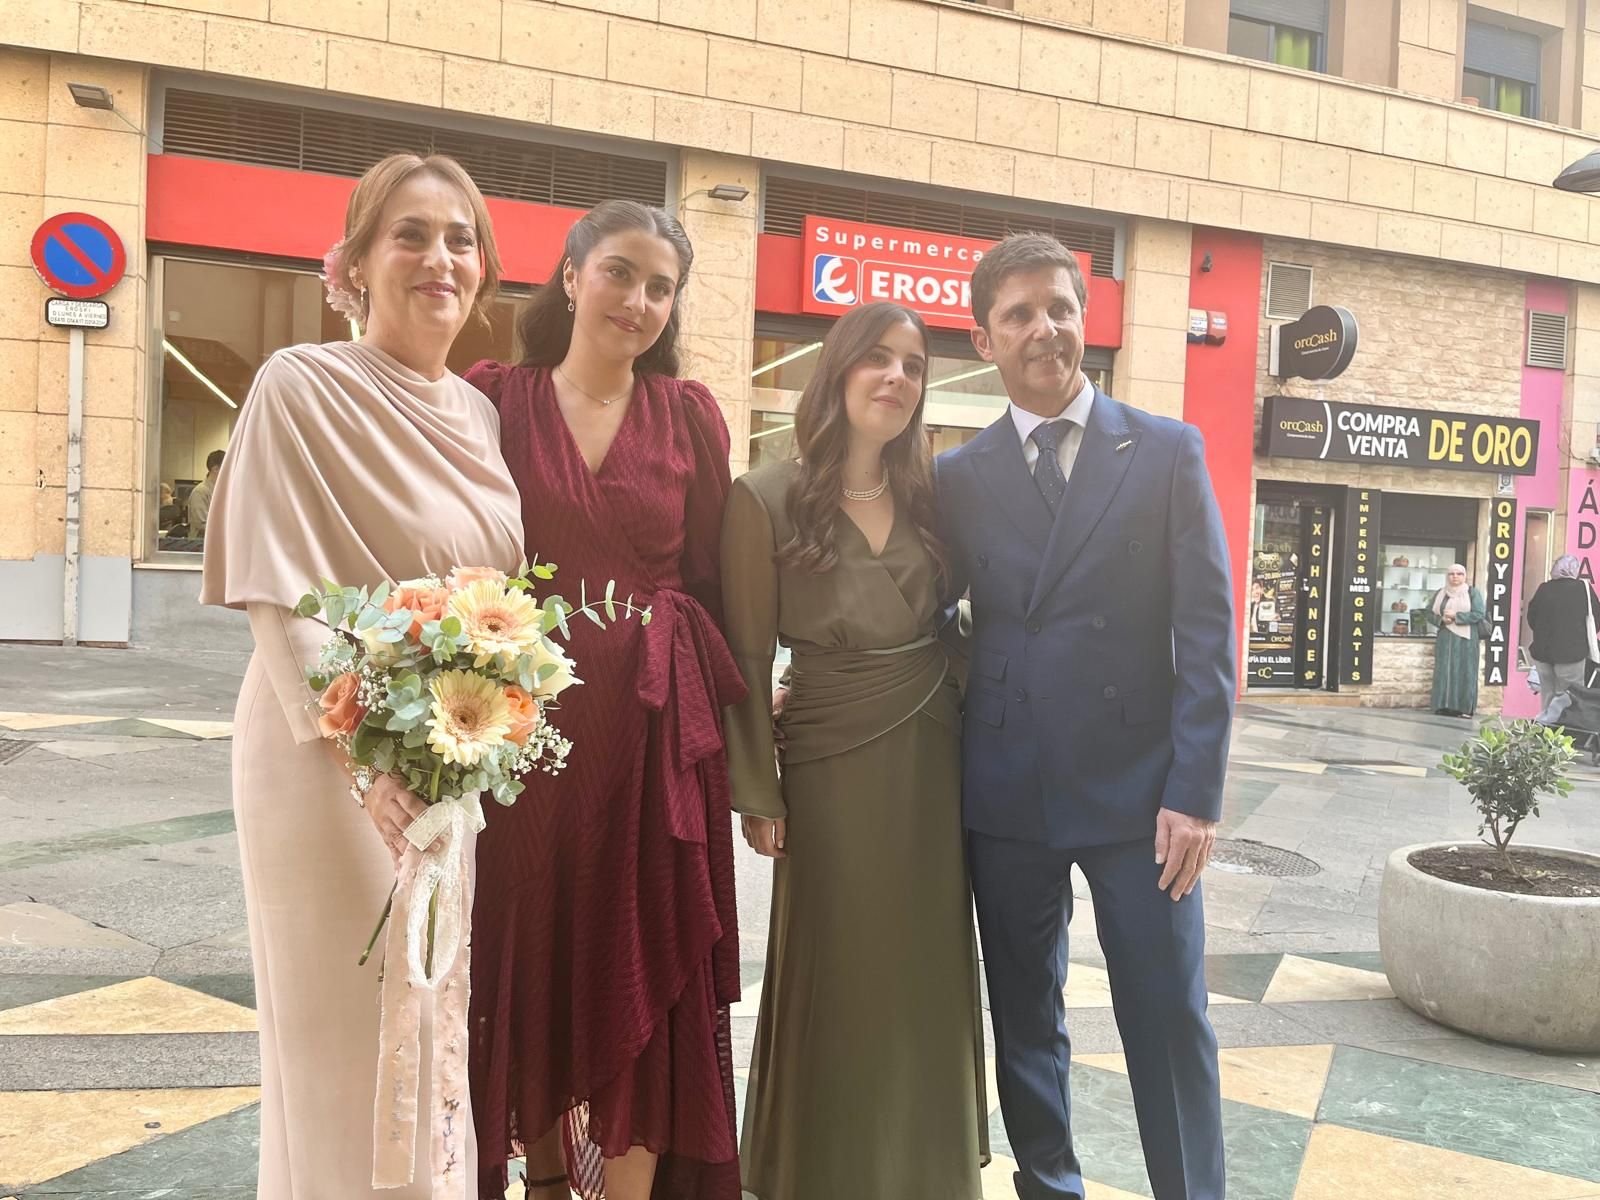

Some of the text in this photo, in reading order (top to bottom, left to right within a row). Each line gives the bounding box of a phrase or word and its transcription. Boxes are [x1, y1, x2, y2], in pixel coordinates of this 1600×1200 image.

[1337, 410, 1421, 437] COMPRA
[1347, 433, 1409, 458] VENTA
[1428, 418, 1532, 467] DE ORO
[1357, 491, 1370, 575] EMPEÑOS
[1349, 577, 1371, 593] UN MES
[1351, 596, 1365, 682] GRATIS
[1275, 655, 1292, 664] LÍDER
